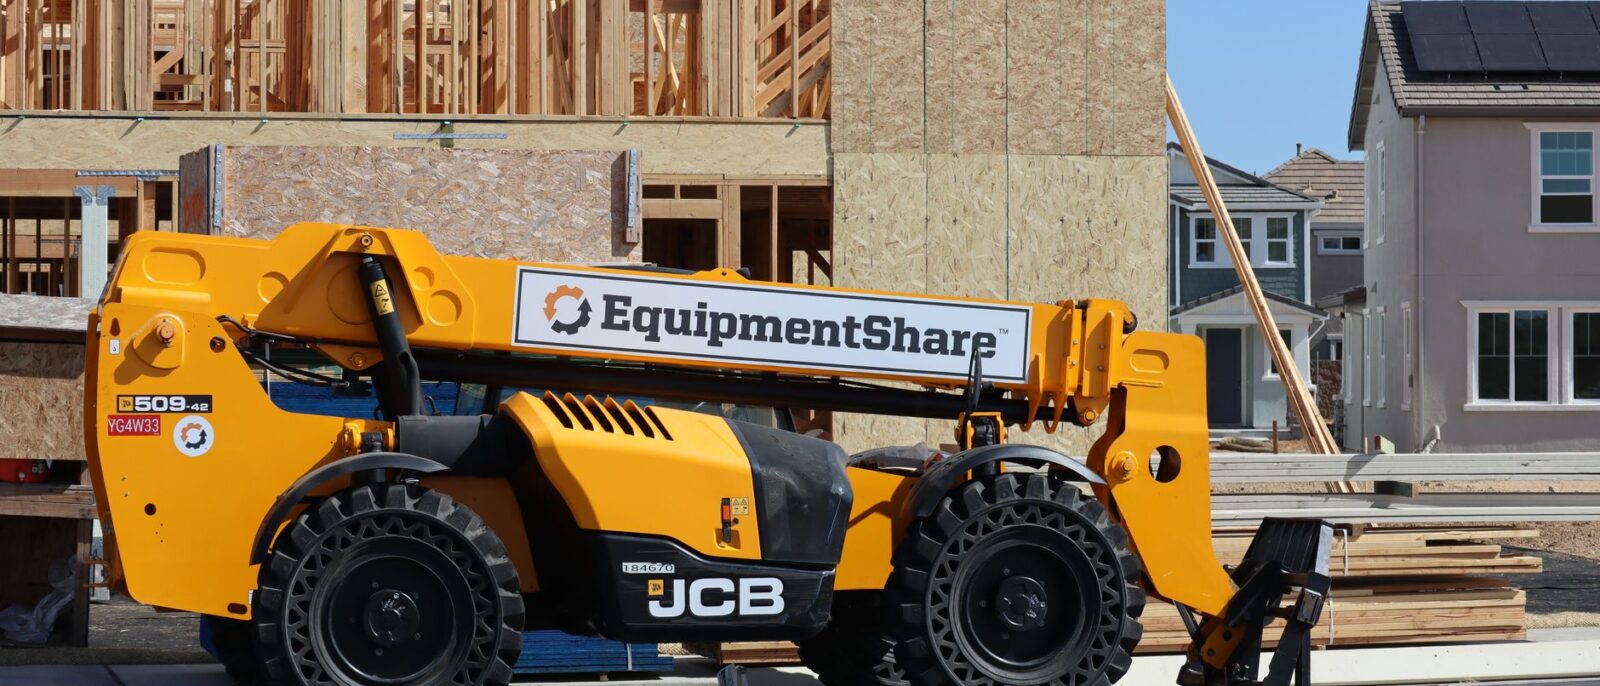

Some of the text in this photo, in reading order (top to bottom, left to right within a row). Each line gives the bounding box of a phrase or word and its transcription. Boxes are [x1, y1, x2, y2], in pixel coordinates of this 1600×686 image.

[601, 294, 996, 359] EquipmentShare
[135, 396, 208, 411] 509-42
[108, 418, 159, 432] YG4W33
[623, 564, 673, 572] 184670
[648, 577, 786, 618] JCB
